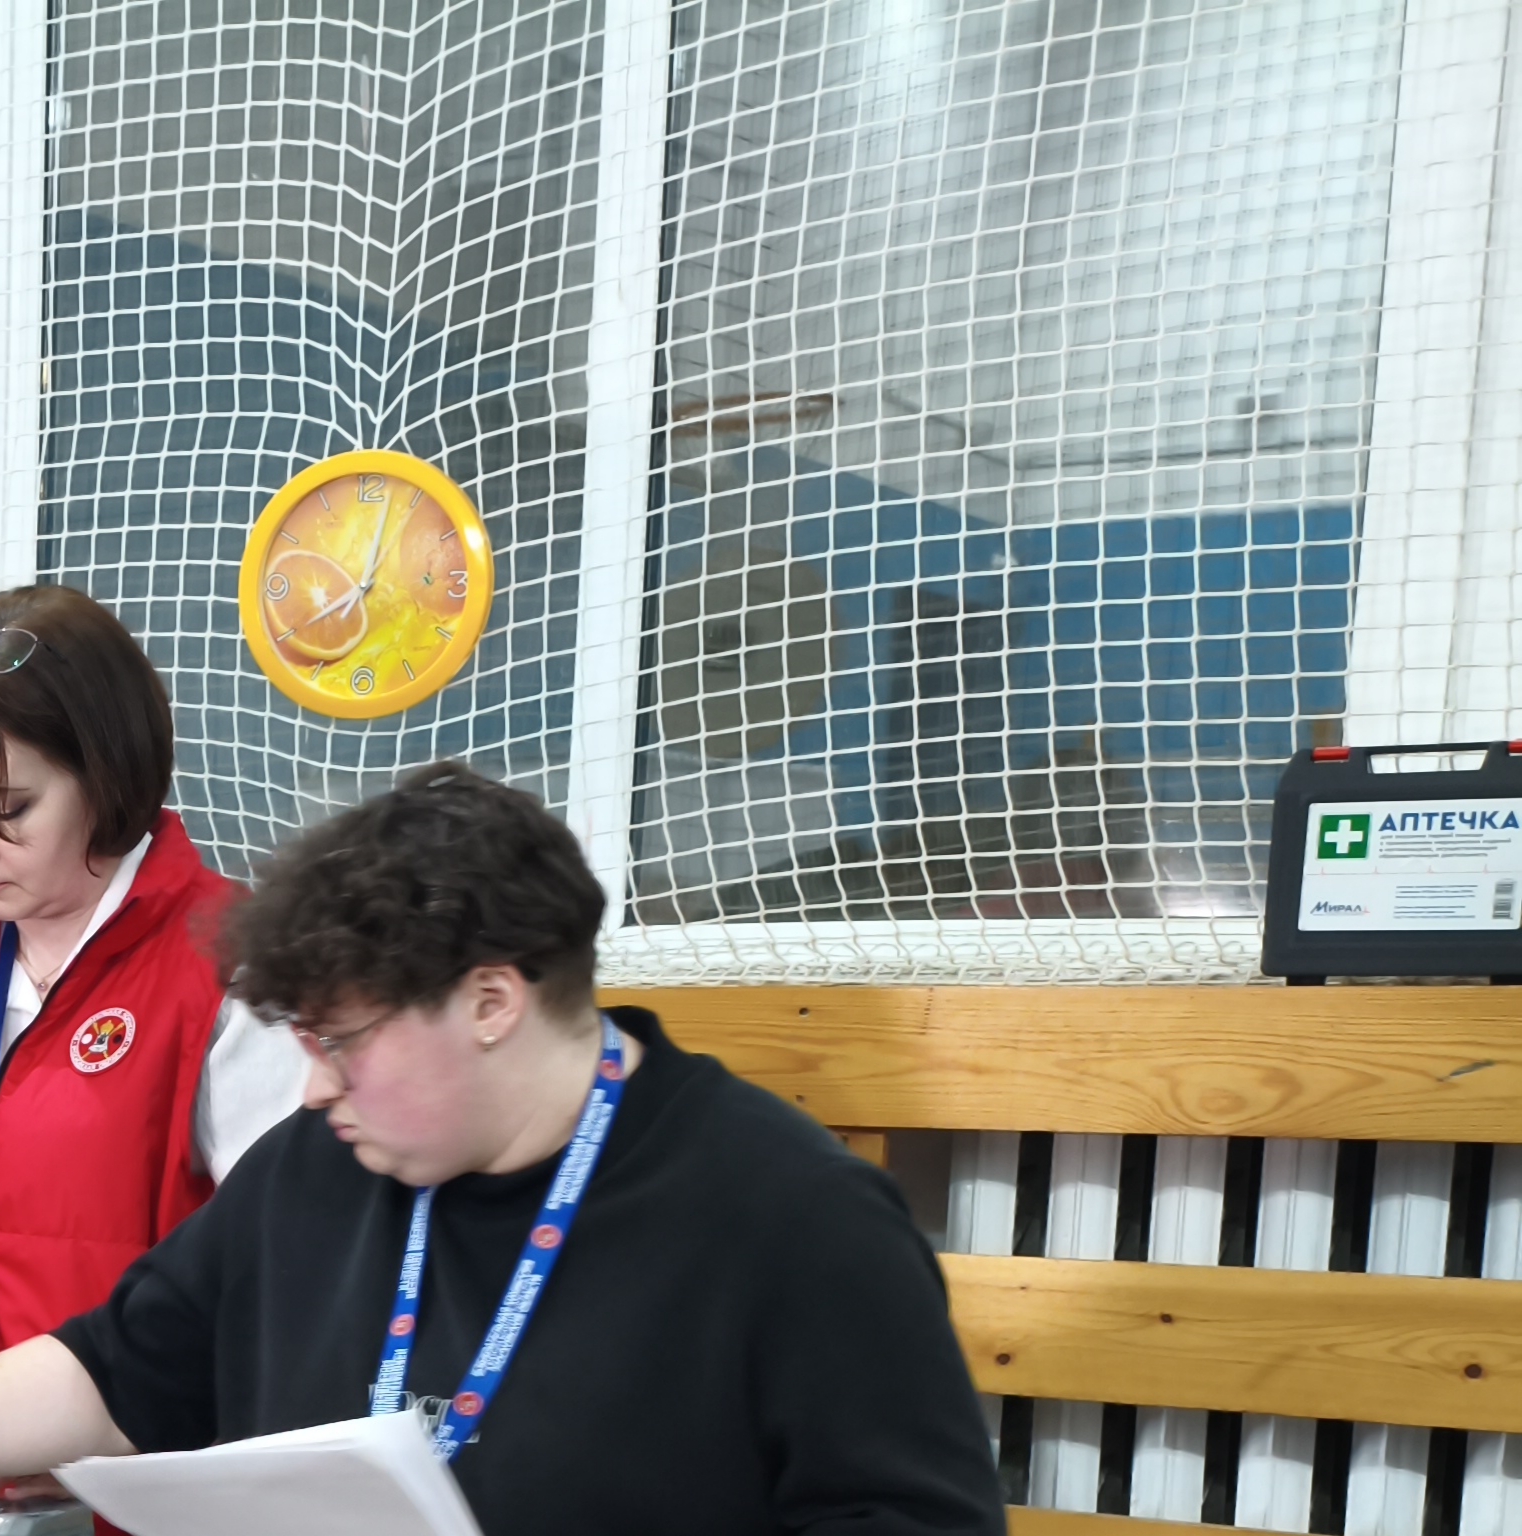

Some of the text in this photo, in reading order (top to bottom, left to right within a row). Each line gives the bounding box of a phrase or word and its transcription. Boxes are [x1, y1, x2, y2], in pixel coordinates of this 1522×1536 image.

[358, 474, 385, 502] 12
[266, 573, 289, 600] 9
[447, 570, 468, 598] 3
[351, 667, 375, 695] 6
[1378, 810, 1520, 832] АПТЕЧКА
